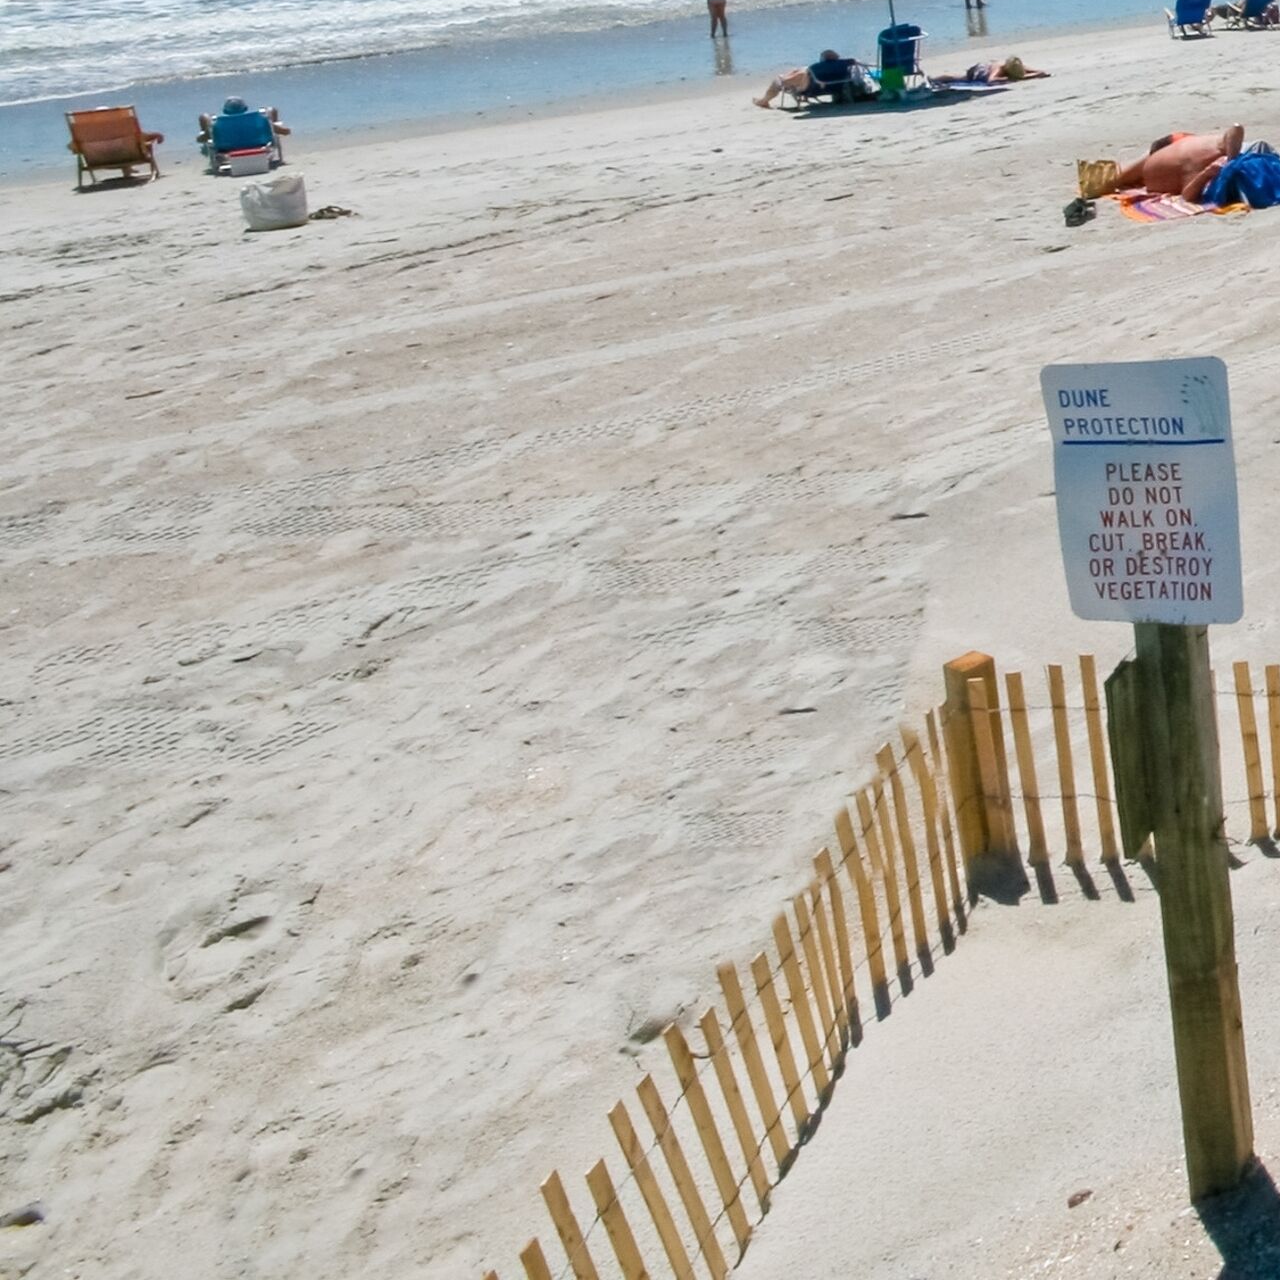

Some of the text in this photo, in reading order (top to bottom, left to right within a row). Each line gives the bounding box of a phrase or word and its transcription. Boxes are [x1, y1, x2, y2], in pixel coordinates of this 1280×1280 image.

[1058, 389, 1110, 408] DUNE
[1064, 417, 1184, 436] PROTECTION
[1106, 463, 1182, 482] PLEASE
[1109, 486, 1182, 505] DO NOT
[1100, 510, 1154, 528] WALK
[1089, 556, 1212, 577] OR DESTROY
[1095, 581, 1212, 601] VEGETATION
